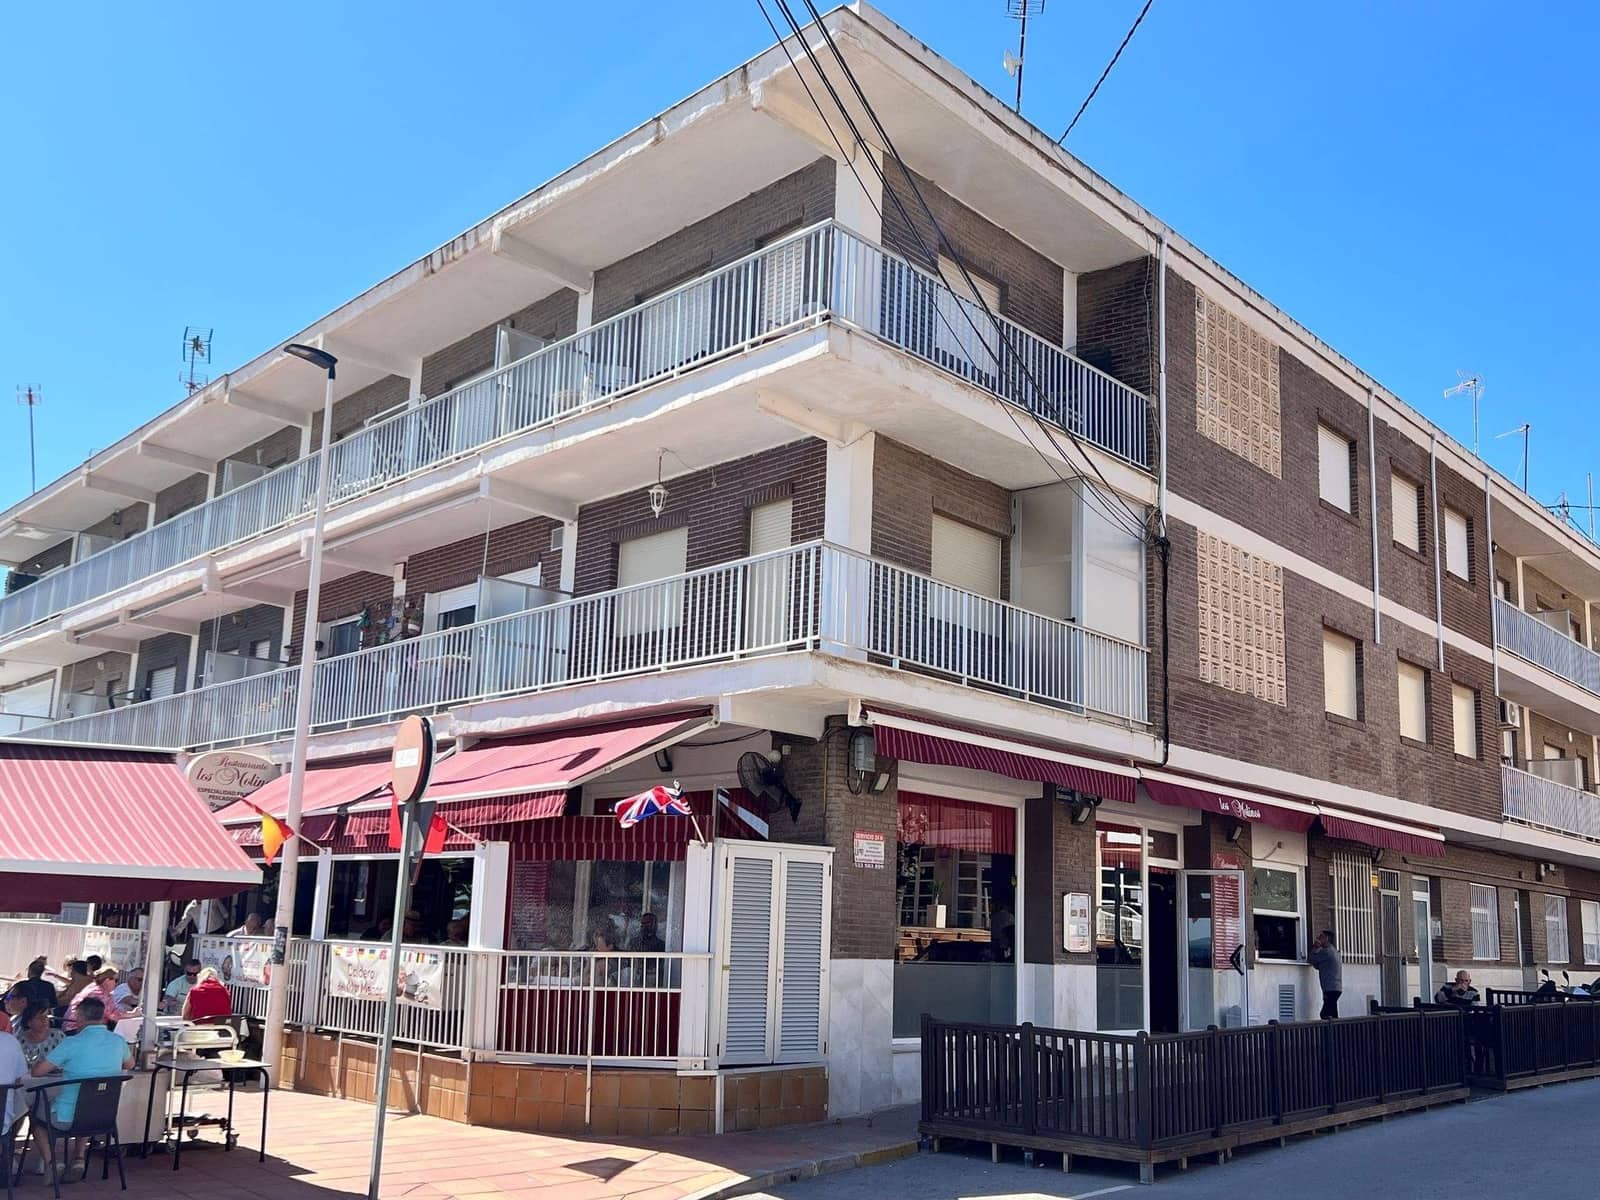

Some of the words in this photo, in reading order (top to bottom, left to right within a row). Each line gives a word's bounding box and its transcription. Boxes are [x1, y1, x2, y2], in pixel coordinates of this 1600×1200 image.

[215, 766, 270, 788] Molin
[197, 787, 236, 795] ESPECIALIDAD
[208, 794, 240, 802] PESCADO
